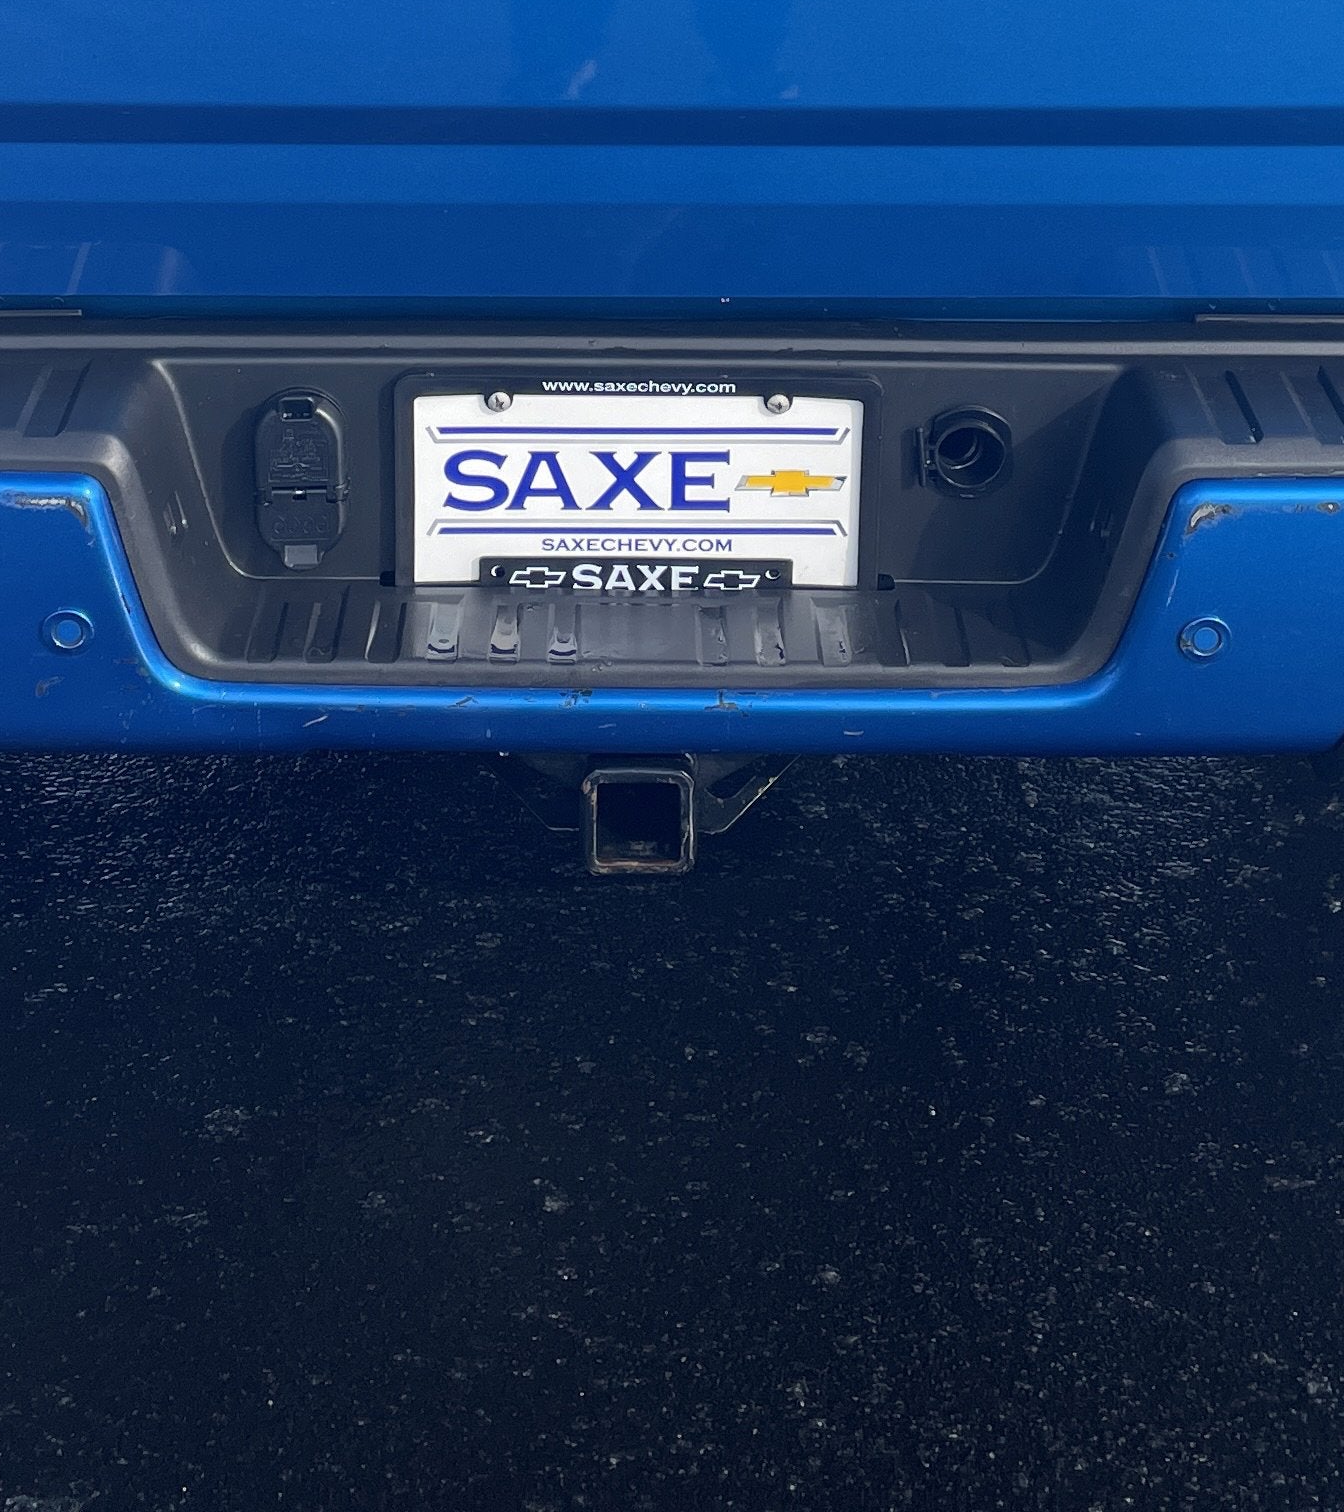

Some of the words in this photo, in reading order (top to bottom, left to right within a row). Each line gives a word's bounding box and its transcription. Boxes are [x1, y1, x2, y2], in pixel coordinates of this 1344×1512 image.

[542, 380, 737, 396] www.saxechevy.com
[442, 448, 732, 513] SAXE
[541, 537, 733, 552] SAXECHEVY.COM
[571, 563, 700, 591] SAXE
